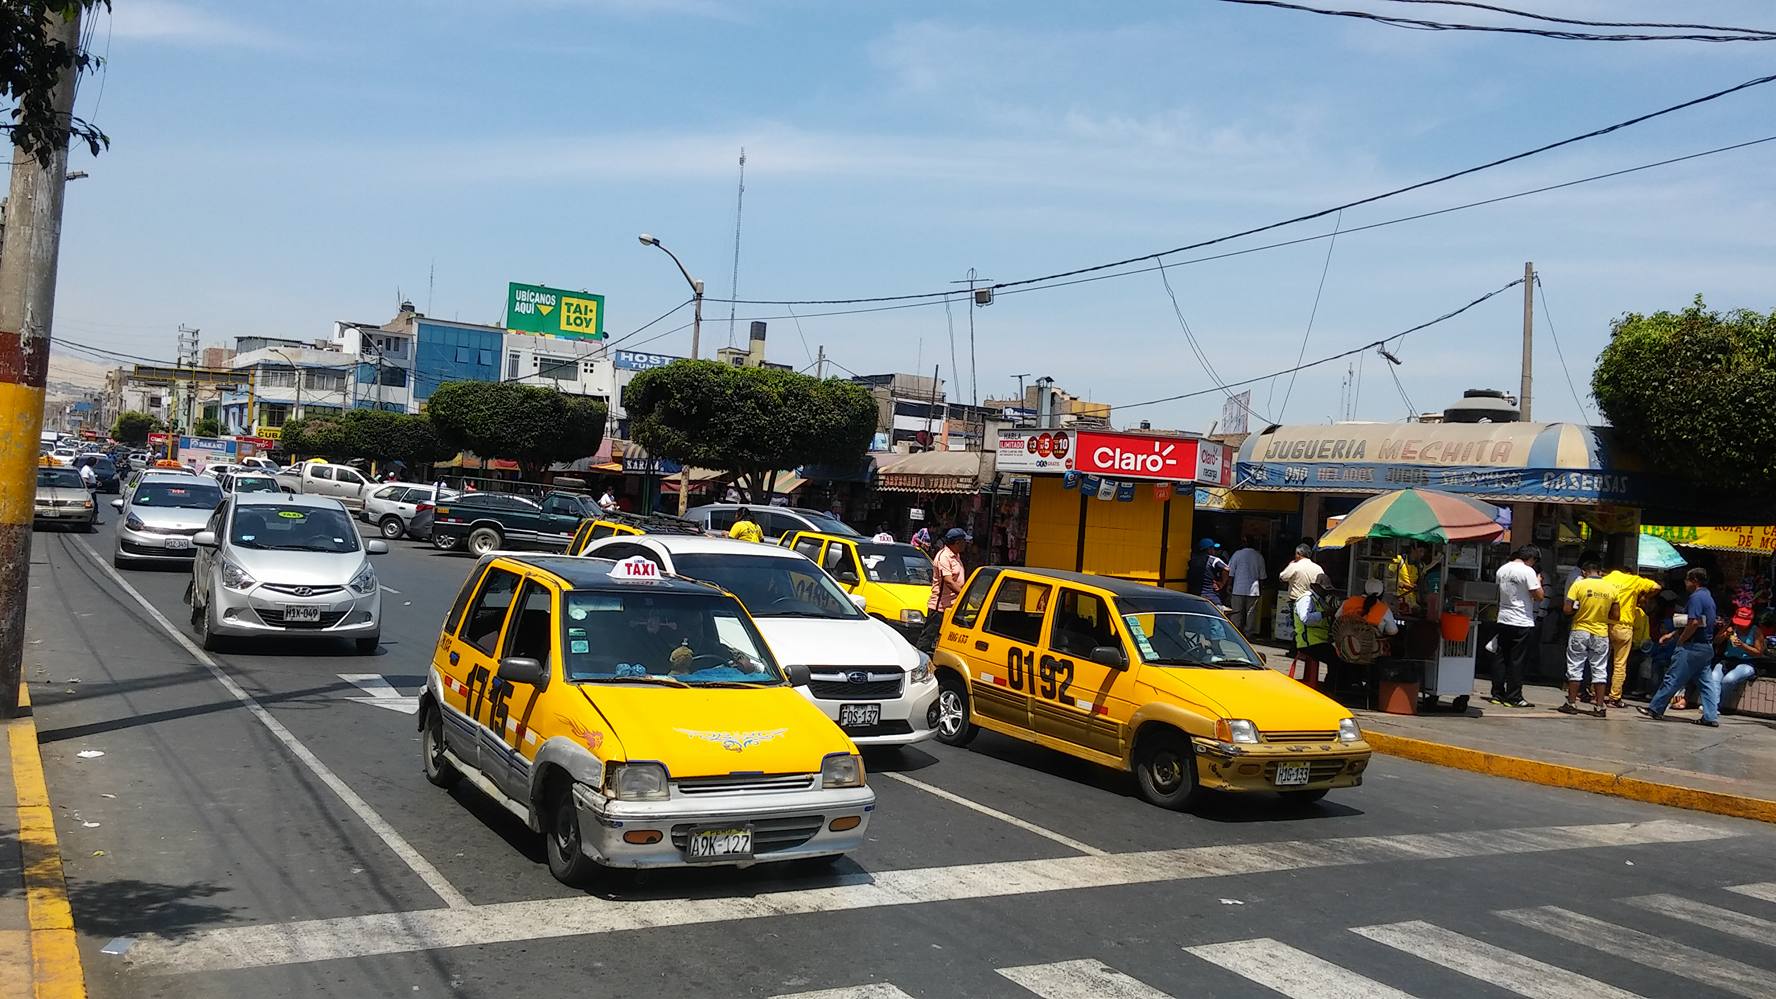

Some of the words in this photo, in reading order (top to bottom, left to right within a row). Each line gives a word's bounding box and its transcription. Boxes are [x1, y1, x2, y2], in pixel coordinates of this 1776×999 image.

[515, 289, 556, 305] UBÍCANOS
[515, 302, 535, 314] AQUÍ
[621, 352, 674, 365] HOST
[257, 431, 282, 439] CUB
[1265, 439, 1367, 460] JUGUERIA
[1378, 438, 1514, 463] MECHITA
[1093, 447, 1163, 472] Claro
[1543, 471, 1628, 493] GASEOSAS
[1737, 535, 1753, 547] DE
[625, 563, 655, 576] TAXI
[1008, 646, 1075, 706] 0192
[690, 834, 750, 857] A9K-127
